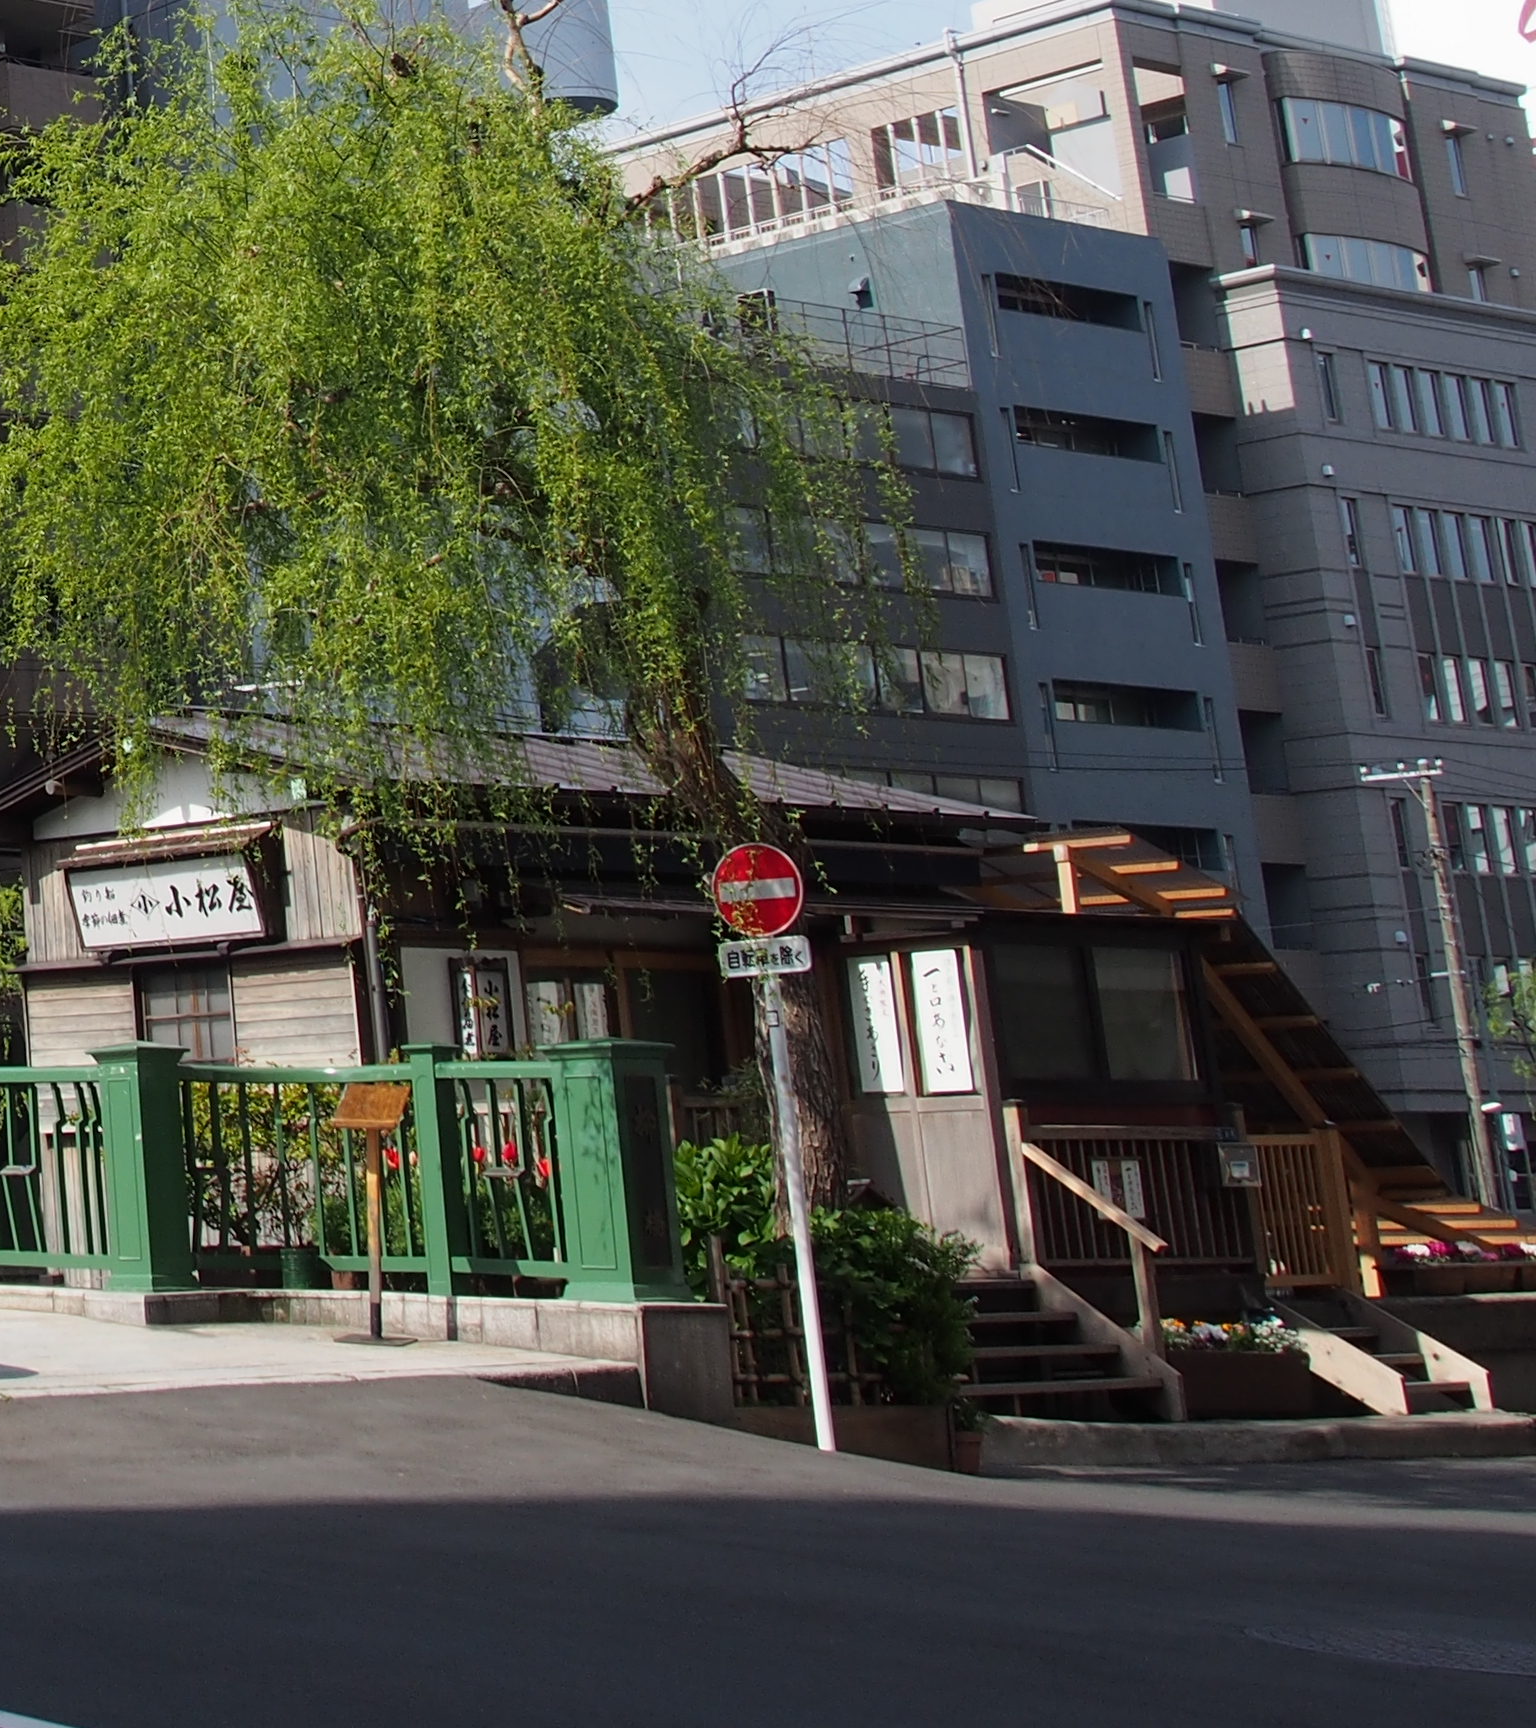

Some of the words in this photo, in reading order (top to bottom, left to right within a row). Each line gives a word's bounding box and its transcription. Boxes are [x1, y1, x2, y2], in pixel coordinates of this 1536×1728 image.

[164, 874, 255, 919] 小松屋
[727, 945, 805, 970] 自転車を除く
